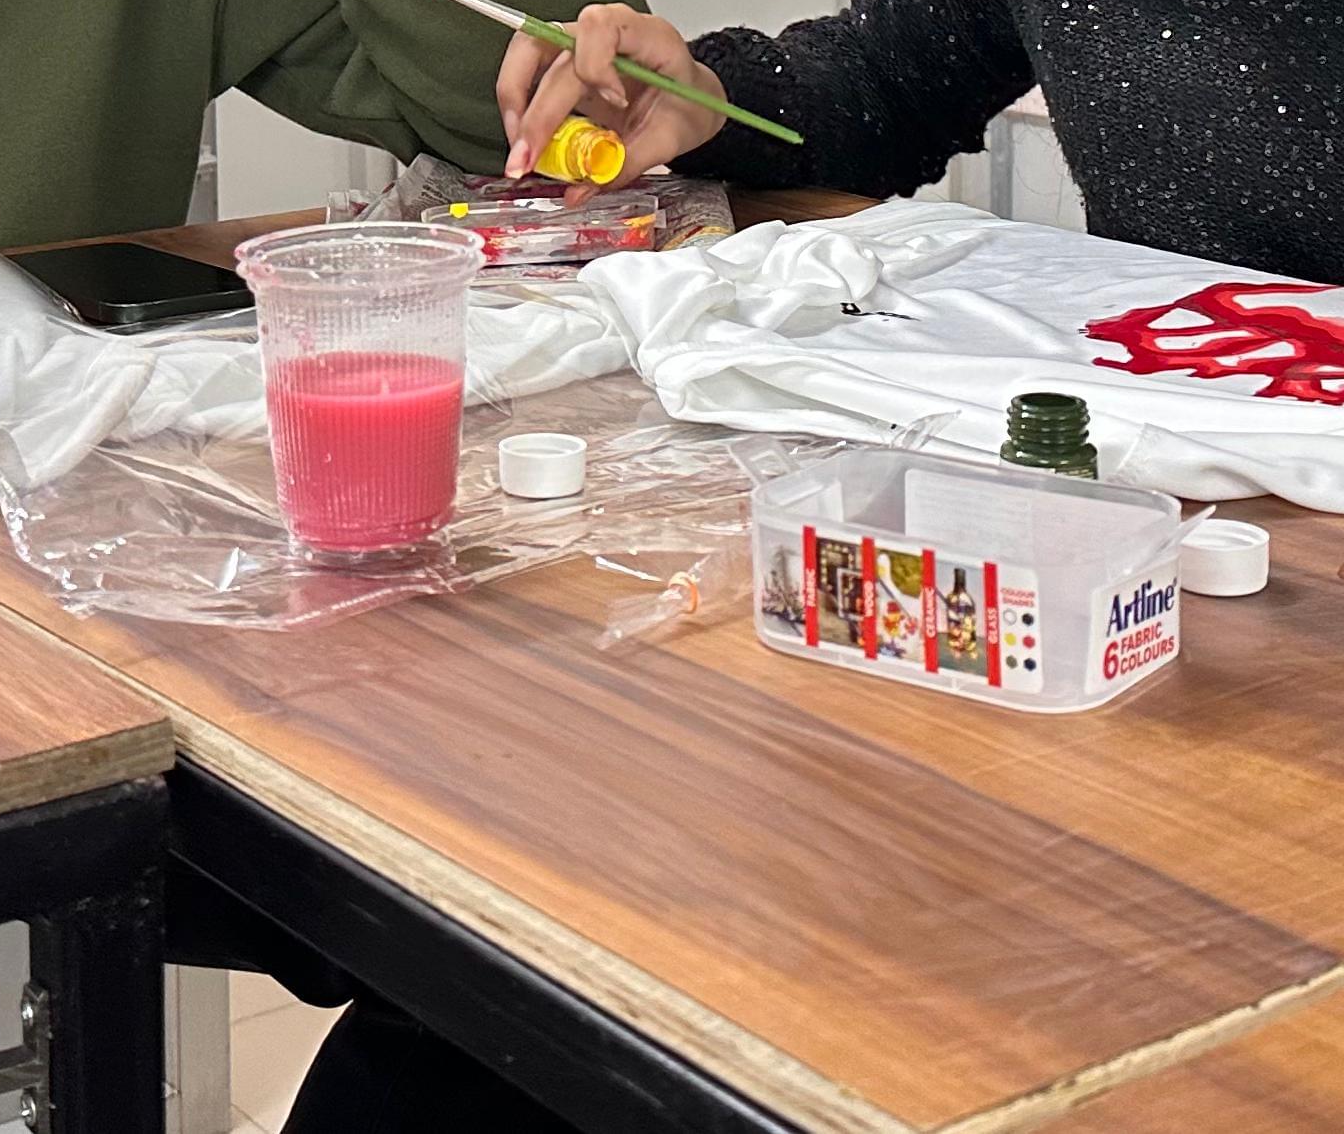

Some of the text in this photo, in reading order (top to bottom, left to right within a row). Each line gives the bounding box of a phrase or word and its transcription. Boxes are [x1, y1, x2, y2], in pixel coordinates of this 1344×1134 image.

[805, 568, 816, 607] FABRIC
[862, 580, 874, 617] WOOD
[923, 587, 935, 638] CERAMIC
[987, 607, 998, 645] GLASS
[1106, 579, 1175, 638] Artline
[1103, 621, 1162, 680] 6 FABRIC
[1120, 635, 1174, 675] COLOURS
